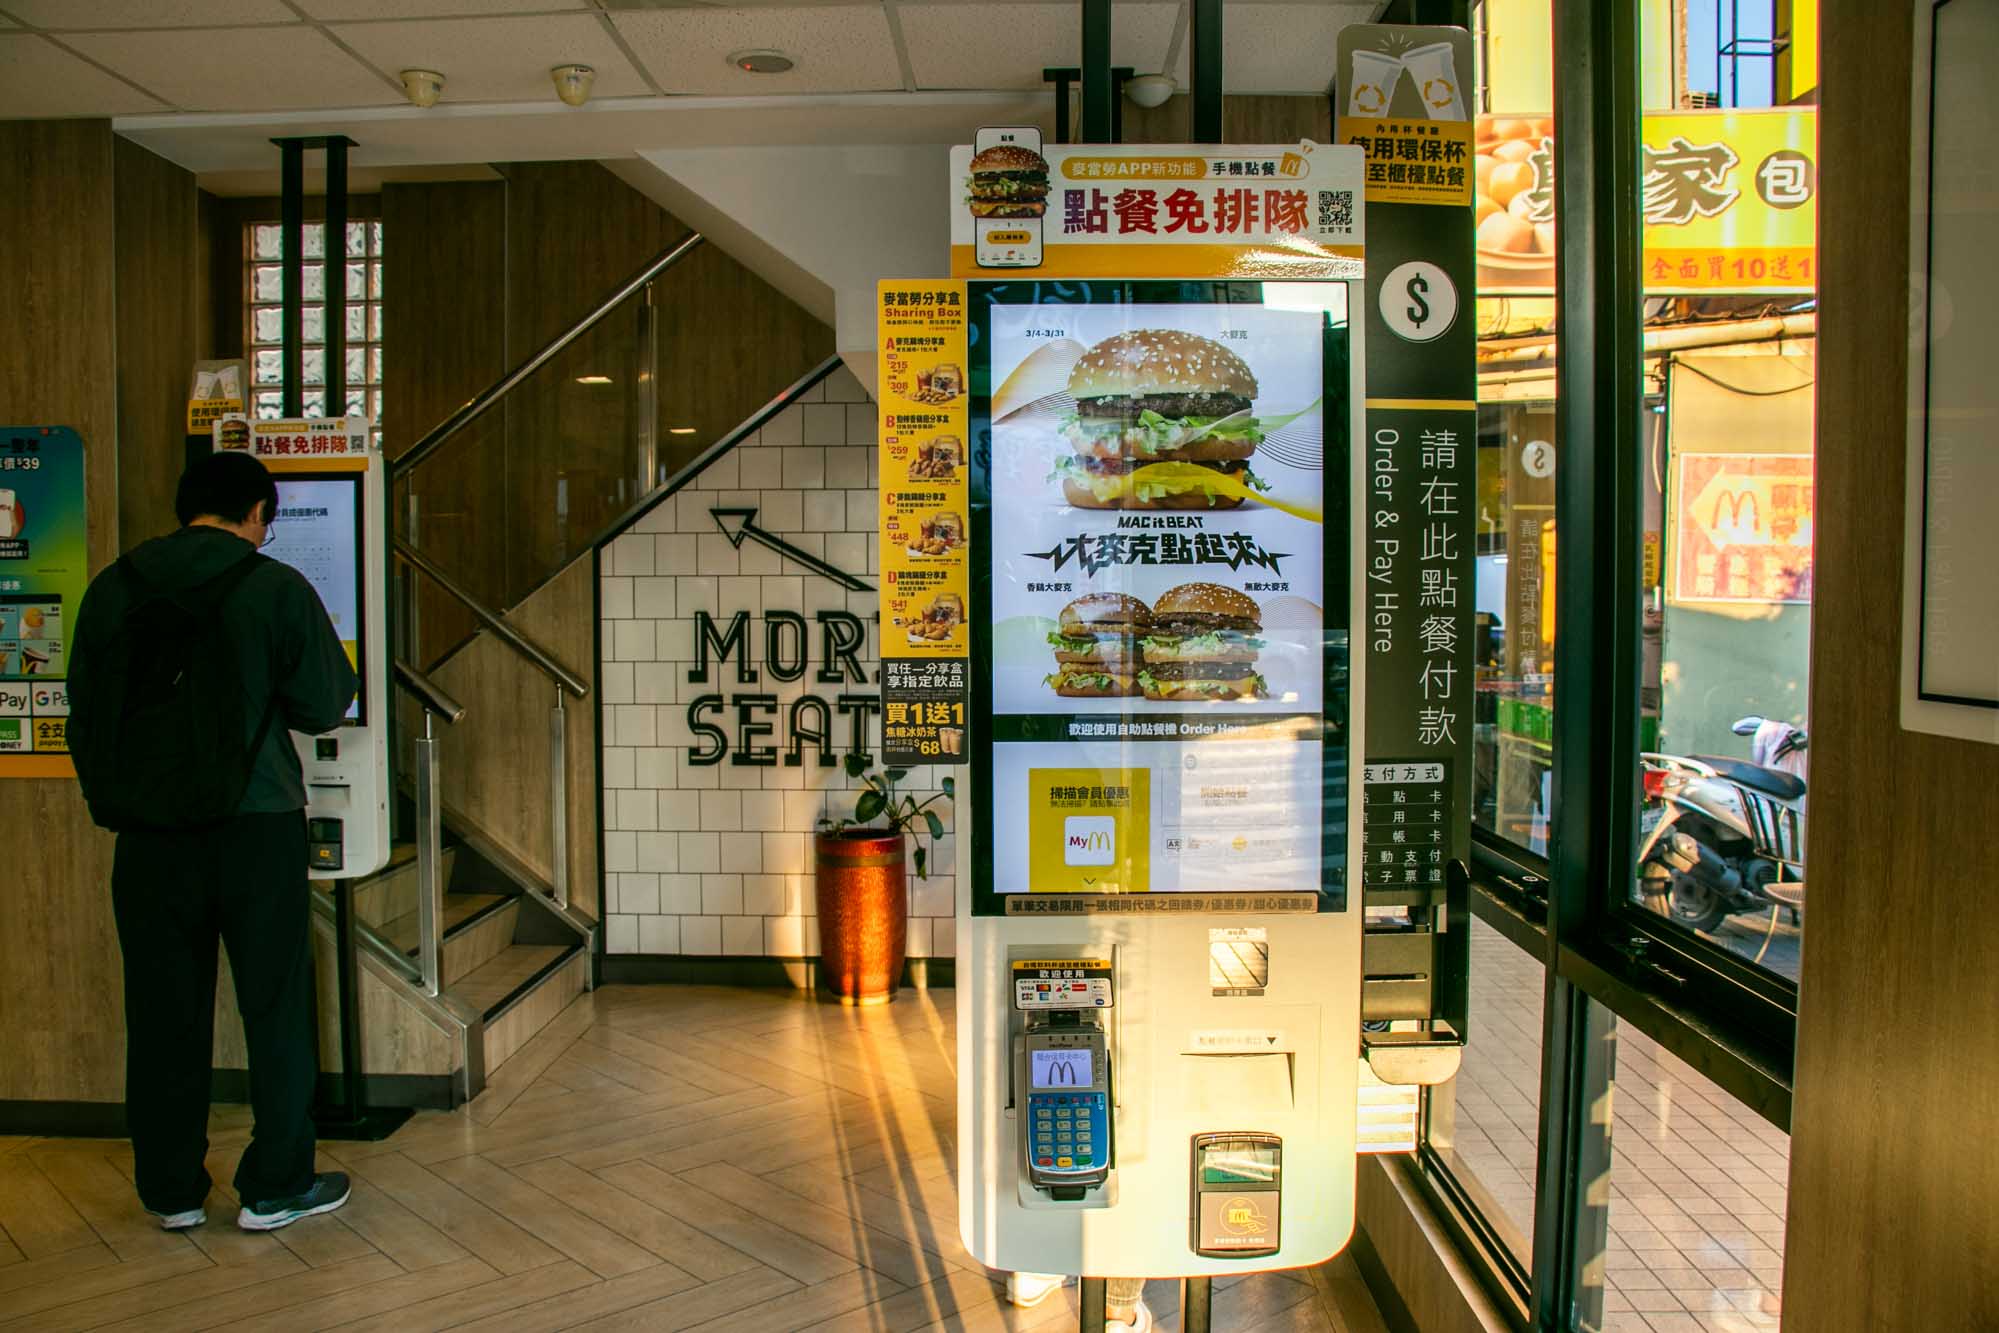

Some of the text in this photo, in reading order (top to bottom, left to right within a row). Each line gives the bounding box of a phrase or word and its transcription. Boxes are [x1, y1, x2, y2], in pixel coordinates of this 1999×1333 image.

[1348, 136, 1467, 163] 使用環保杯
[1071, 161, 1276, 177] 麥當勞APP新功能 手機點餐
[1365, 163, 1465, 186] 至櫃檯點餐
[1062, 187, 1311, 236] 點餐免排隊
[883, 291, 961, 306] 麥當勞分享盒
[884, 307, 962, 320] Sharing Box
[1025, 329, 1065, 337] 3/4-3/31
[1220, 329, 1248, 340] 大麥克
[886, 337, 895, 350] A
[886, 415, 895, 428] B
[256, 435, 348, 455] 點餐免排隊
[1375, 428, 1399, 502] Order
[886, 493, 896, 505] C
[1117, 516, 1152, 528] MAC
[1167, 516, 1203, 528] BEAT
[1369, 539, 1399, 585] Pay
[887, 571, 897, 583] D
[1418, 428, 1459, 745] 請在此點餐付款
[1375, 593, 1399, 653] Here
[688, 610, 880, 683] MOR
[887, 662, 963, 675] 買任一分享盒
[887, 675, 964, 688] 享指定飲品
[0, 692, 27, 711] Pay
[52, 691, 70, 706] Pa
[885, 702, 965, 725] 買1送1
[885, 726, 937, 738] 焦糖冰奶茶
[1068, 723, 1177, 736] 歡迎使用自助點餐機
[1179, 723, 1216, 736] Order
[1364, 766, 1439, 781] 支付方式
[1049, 786, 1129, 800] 掃描會員優惠
[1069, 835, 1088, 849] My
[1039, 969, 1085, 979] 歡迎使用
